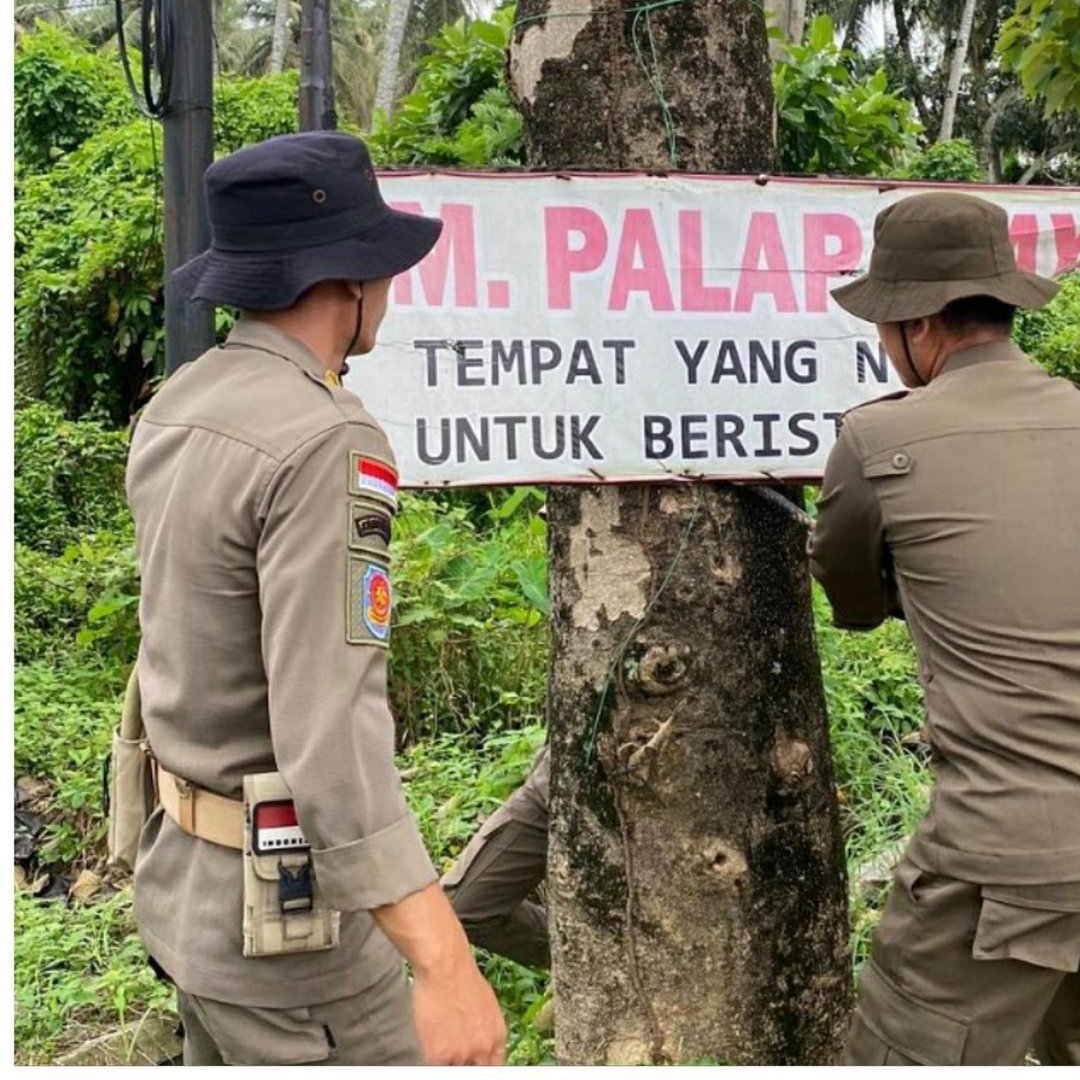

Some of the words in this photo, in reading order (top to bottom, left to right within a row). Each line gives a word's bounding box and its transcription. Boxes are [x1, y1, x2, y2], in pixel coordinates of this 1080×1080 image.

[544, 205, 864, 314] PALAP
[414, 339, 636, 389] TEMPAT
[677, 339, 818, 385] YANG
[415, 414, 604, 467] UNTUK
[643, 411, 845, 460] BERIST
